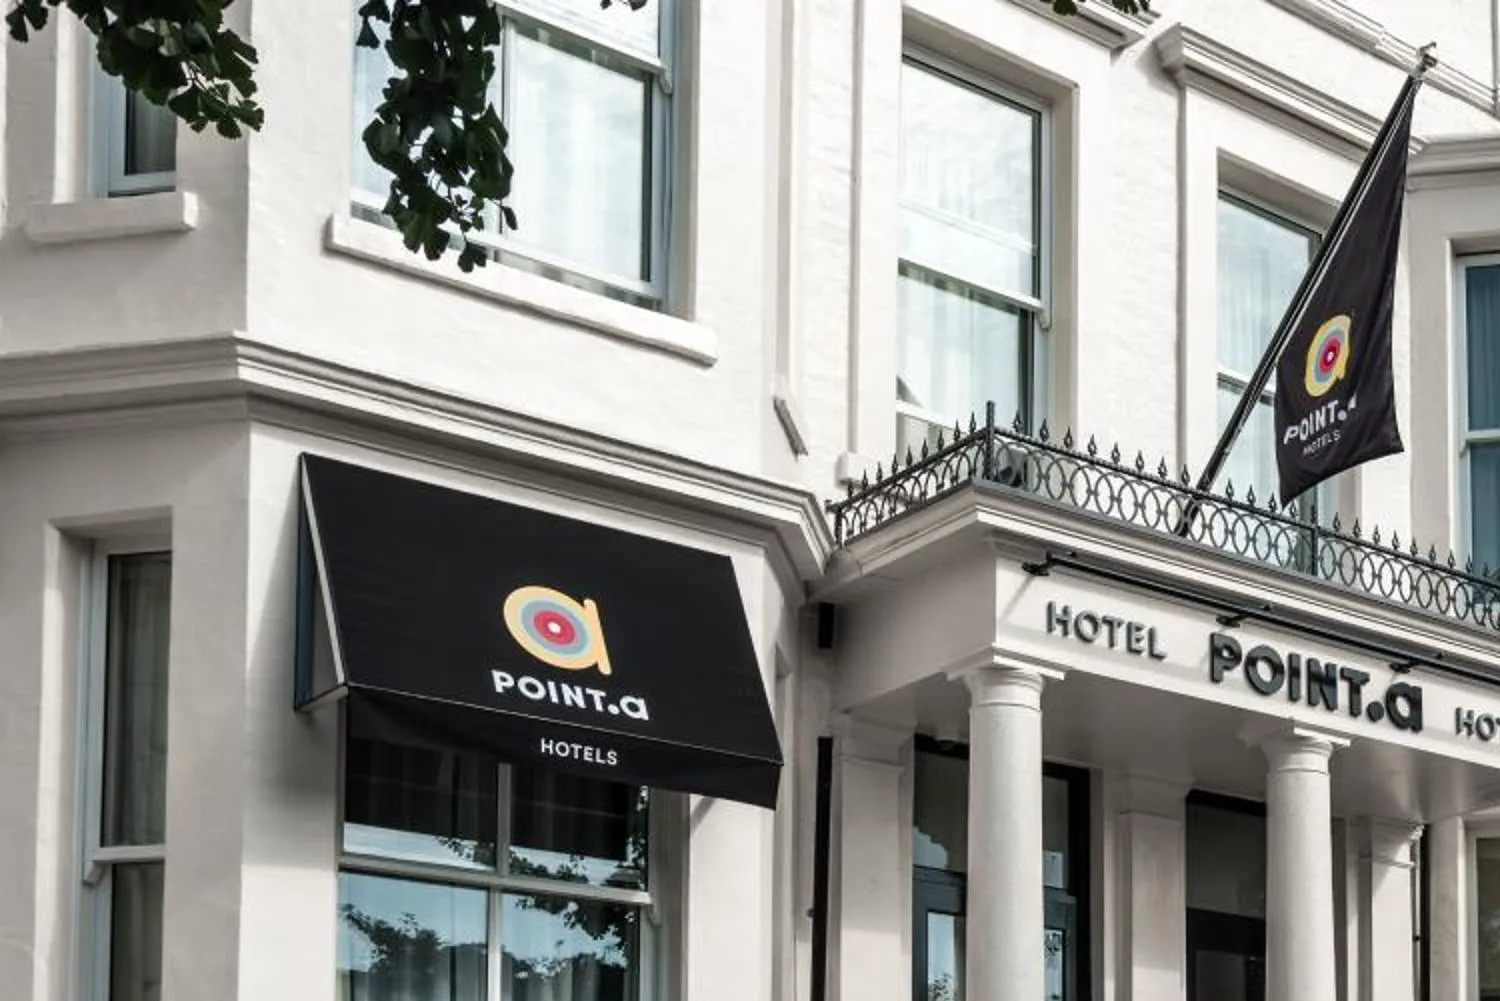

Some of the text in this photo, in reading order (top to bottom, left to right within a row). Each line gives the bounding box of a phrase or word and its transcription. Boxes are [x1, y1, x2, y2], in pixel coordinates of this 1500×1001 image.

[1047, 601, 1167, 660] HOTEL
[1209, 632, 1424, 733] POINT.a
[491, 669, 649, 721] POINT.a
[540, 737, 618, 766] HOTELS
